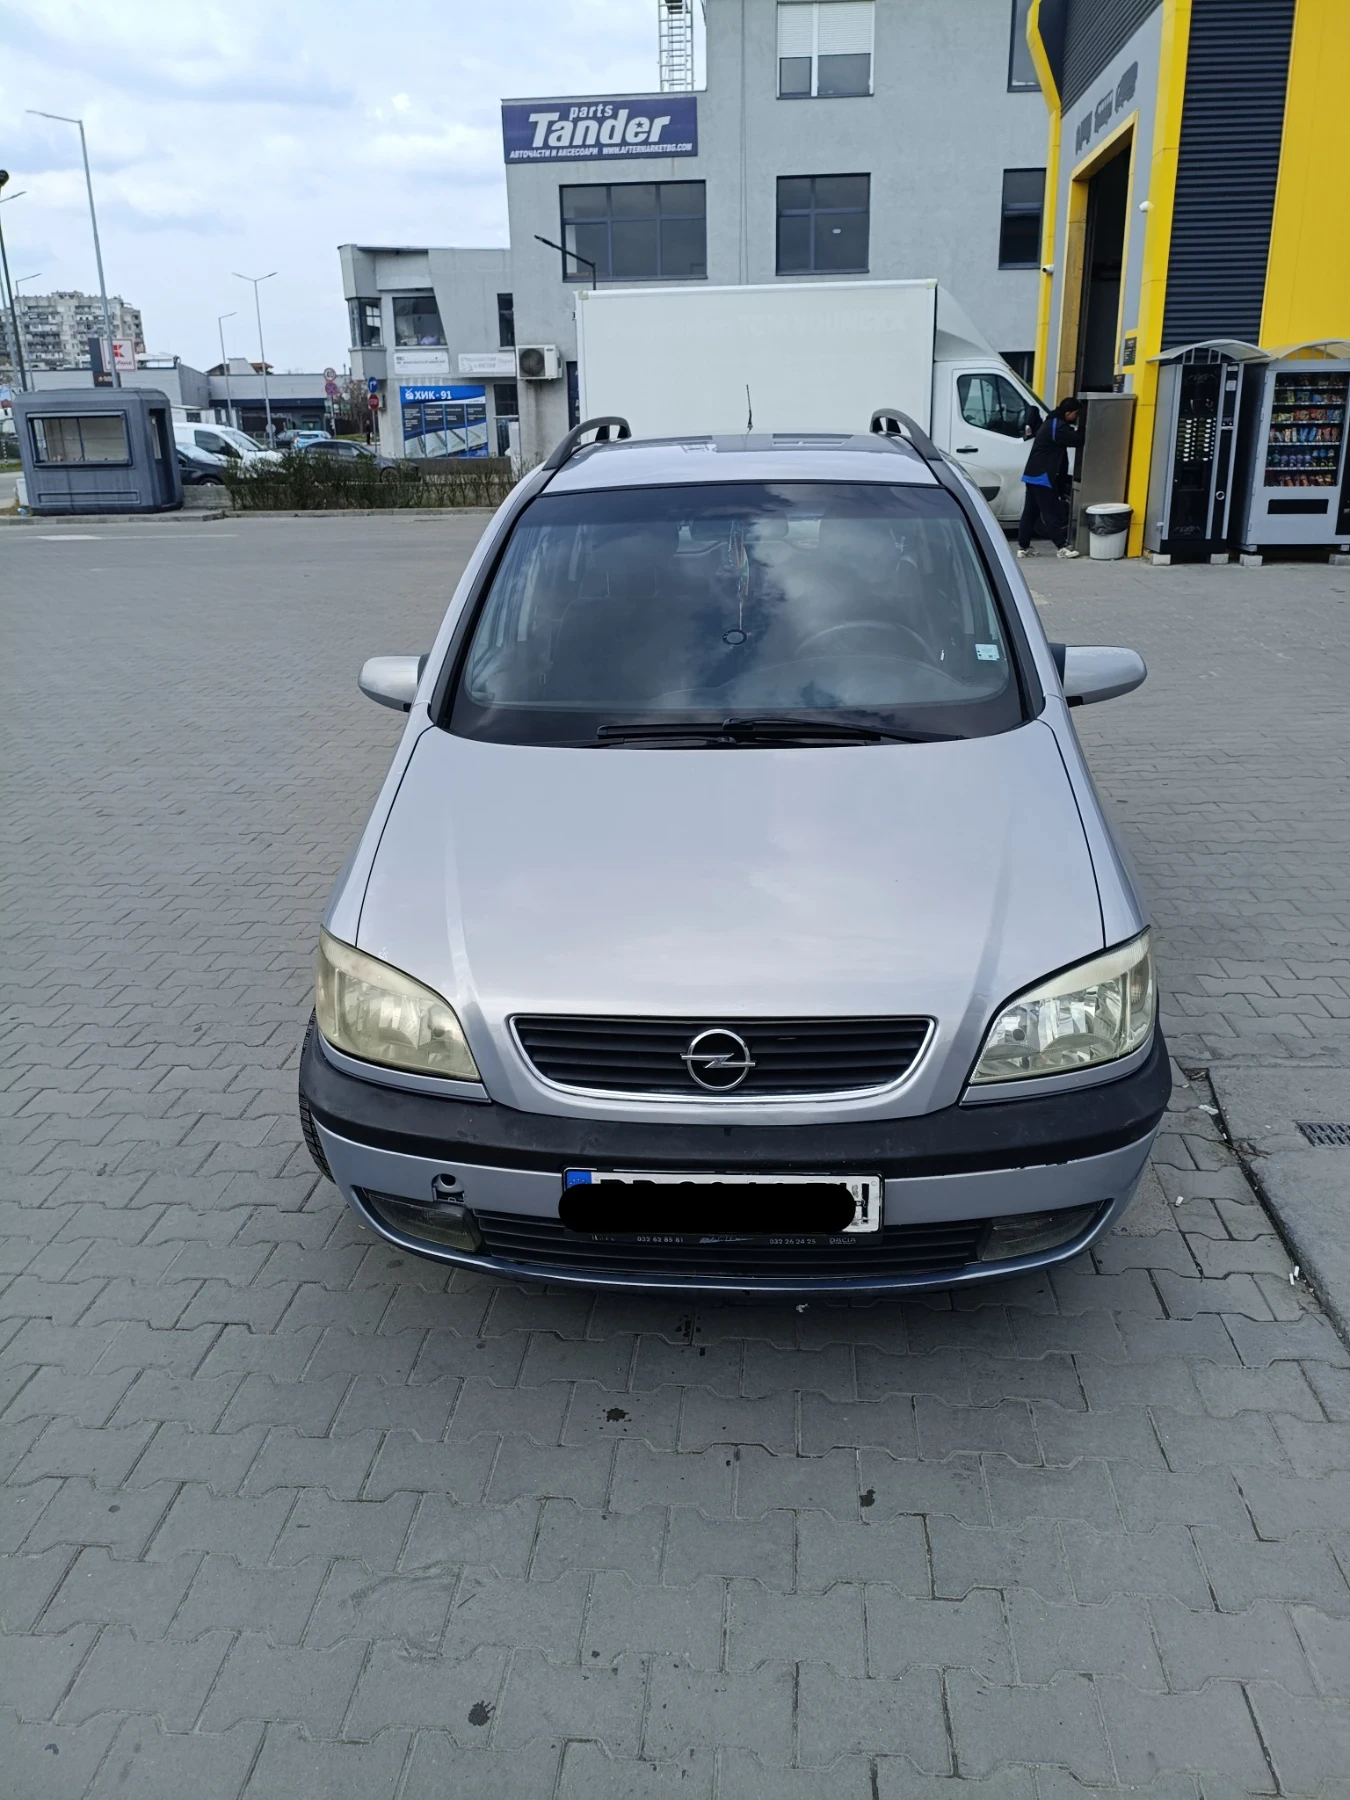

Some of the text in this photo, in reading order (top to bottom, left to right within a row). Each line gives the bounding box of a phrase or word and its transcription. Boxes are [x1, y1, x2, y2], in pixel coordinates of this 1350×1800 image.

[569, 103, 614, 121] parts
[528, 109, 671, 148] Tander
[509, 147, 599, 159] АВТОЧАСТИ И АКСЕСОАРИ
[602, 142, 693, 155] WWW.AFTERMARKETBG.COM
[414, 390, 435, 400] ХИК
[440, 390, 452, 400] 91
[829, 1237, 857, 1245] DACIA
